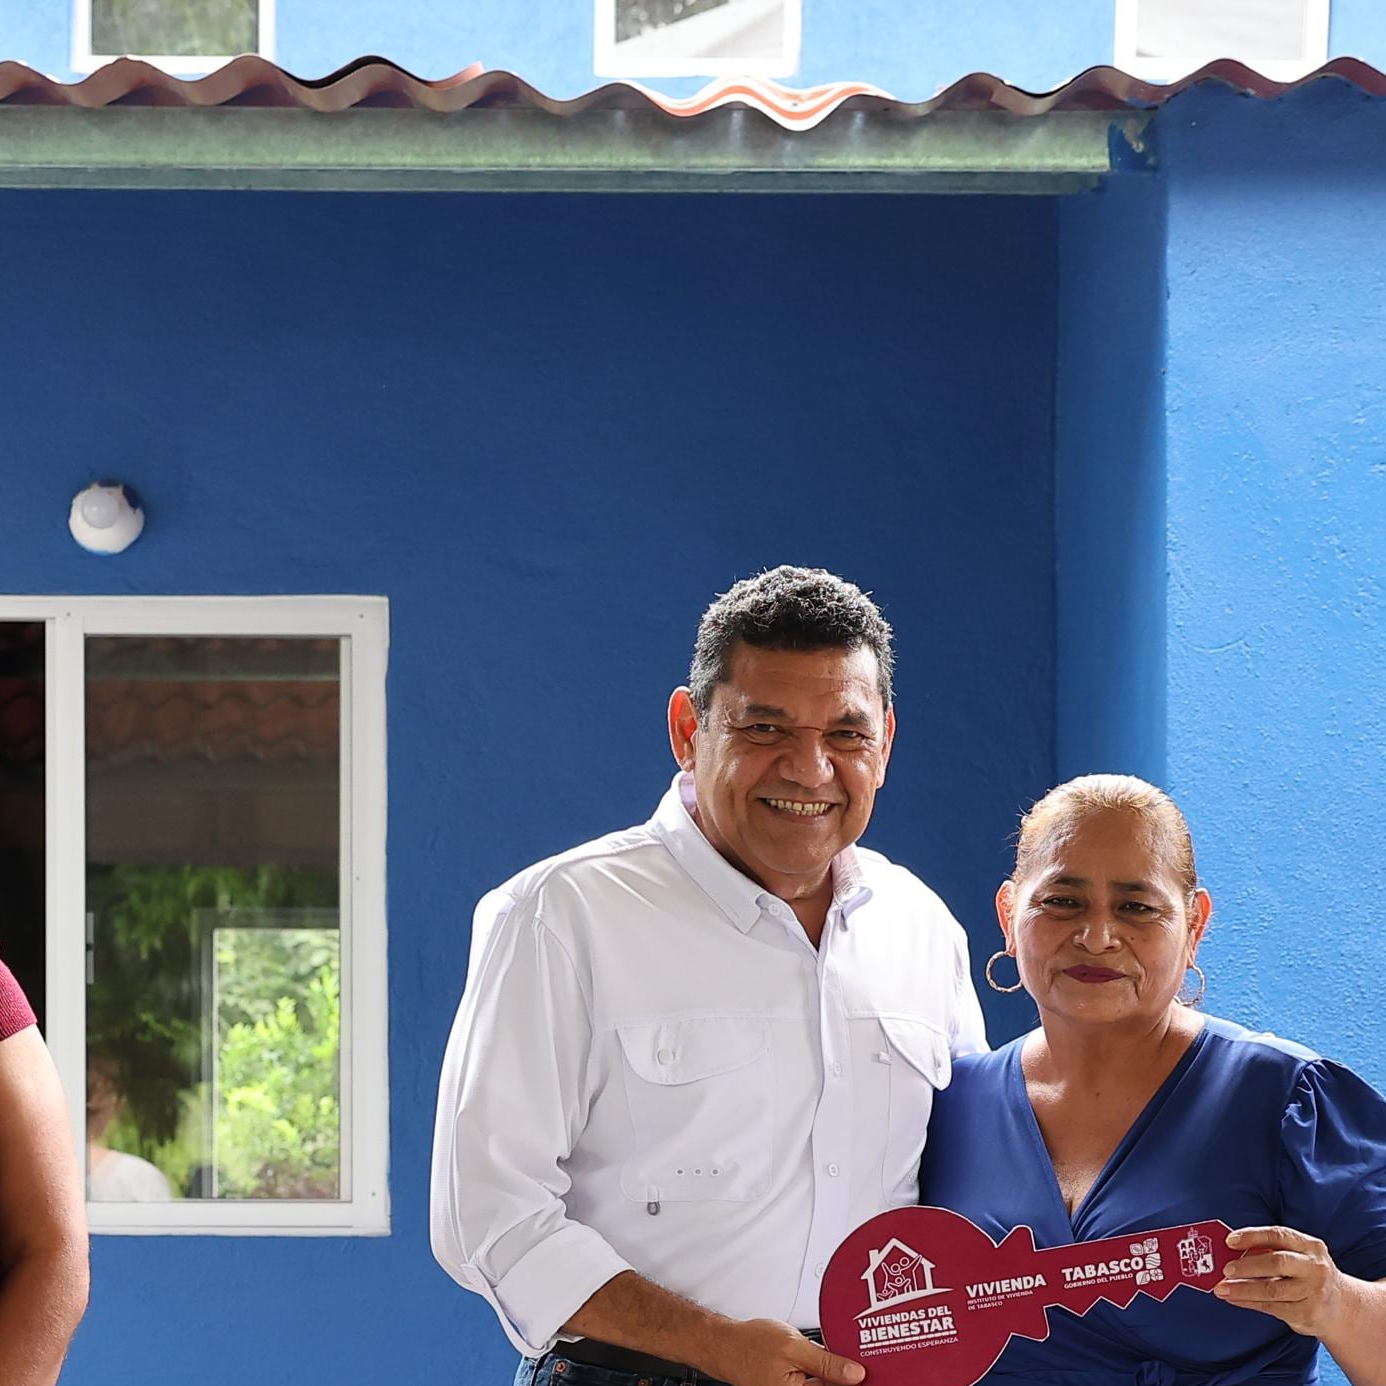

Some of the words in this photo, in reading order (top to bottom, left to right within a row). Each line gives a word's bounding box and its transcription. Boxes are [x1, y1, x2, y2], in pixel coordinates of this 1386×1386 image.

[1061, 1256, 1144, 1282] TABASCO
[966, 1274, 1047, 1298] VIVIENDA
[1064, 1279, 1096, 1290] GOBIERNO
[1096, 1276, 1109, 1284] DEL
[1109, 1272, 1134, 1282] PUEBLO
[967, 1295, 997, 1305] INSTITUTO
[1006, 1290, 1034, 1299] VIVIENDA
[967, 1302, 976, 1311] DE
[977, 1300, 1004, 1310] TABASCO
[858, 1308, 926, 1328] VIVIENDAS
[927, 1305, 952, 1318] DEL
[859, 1316, 955, 1344] BIENESTAR
[860, 1343, 917, 1358] CONSTRUYENDO
[917, 1336, 959, 1349] ESPERANZA
